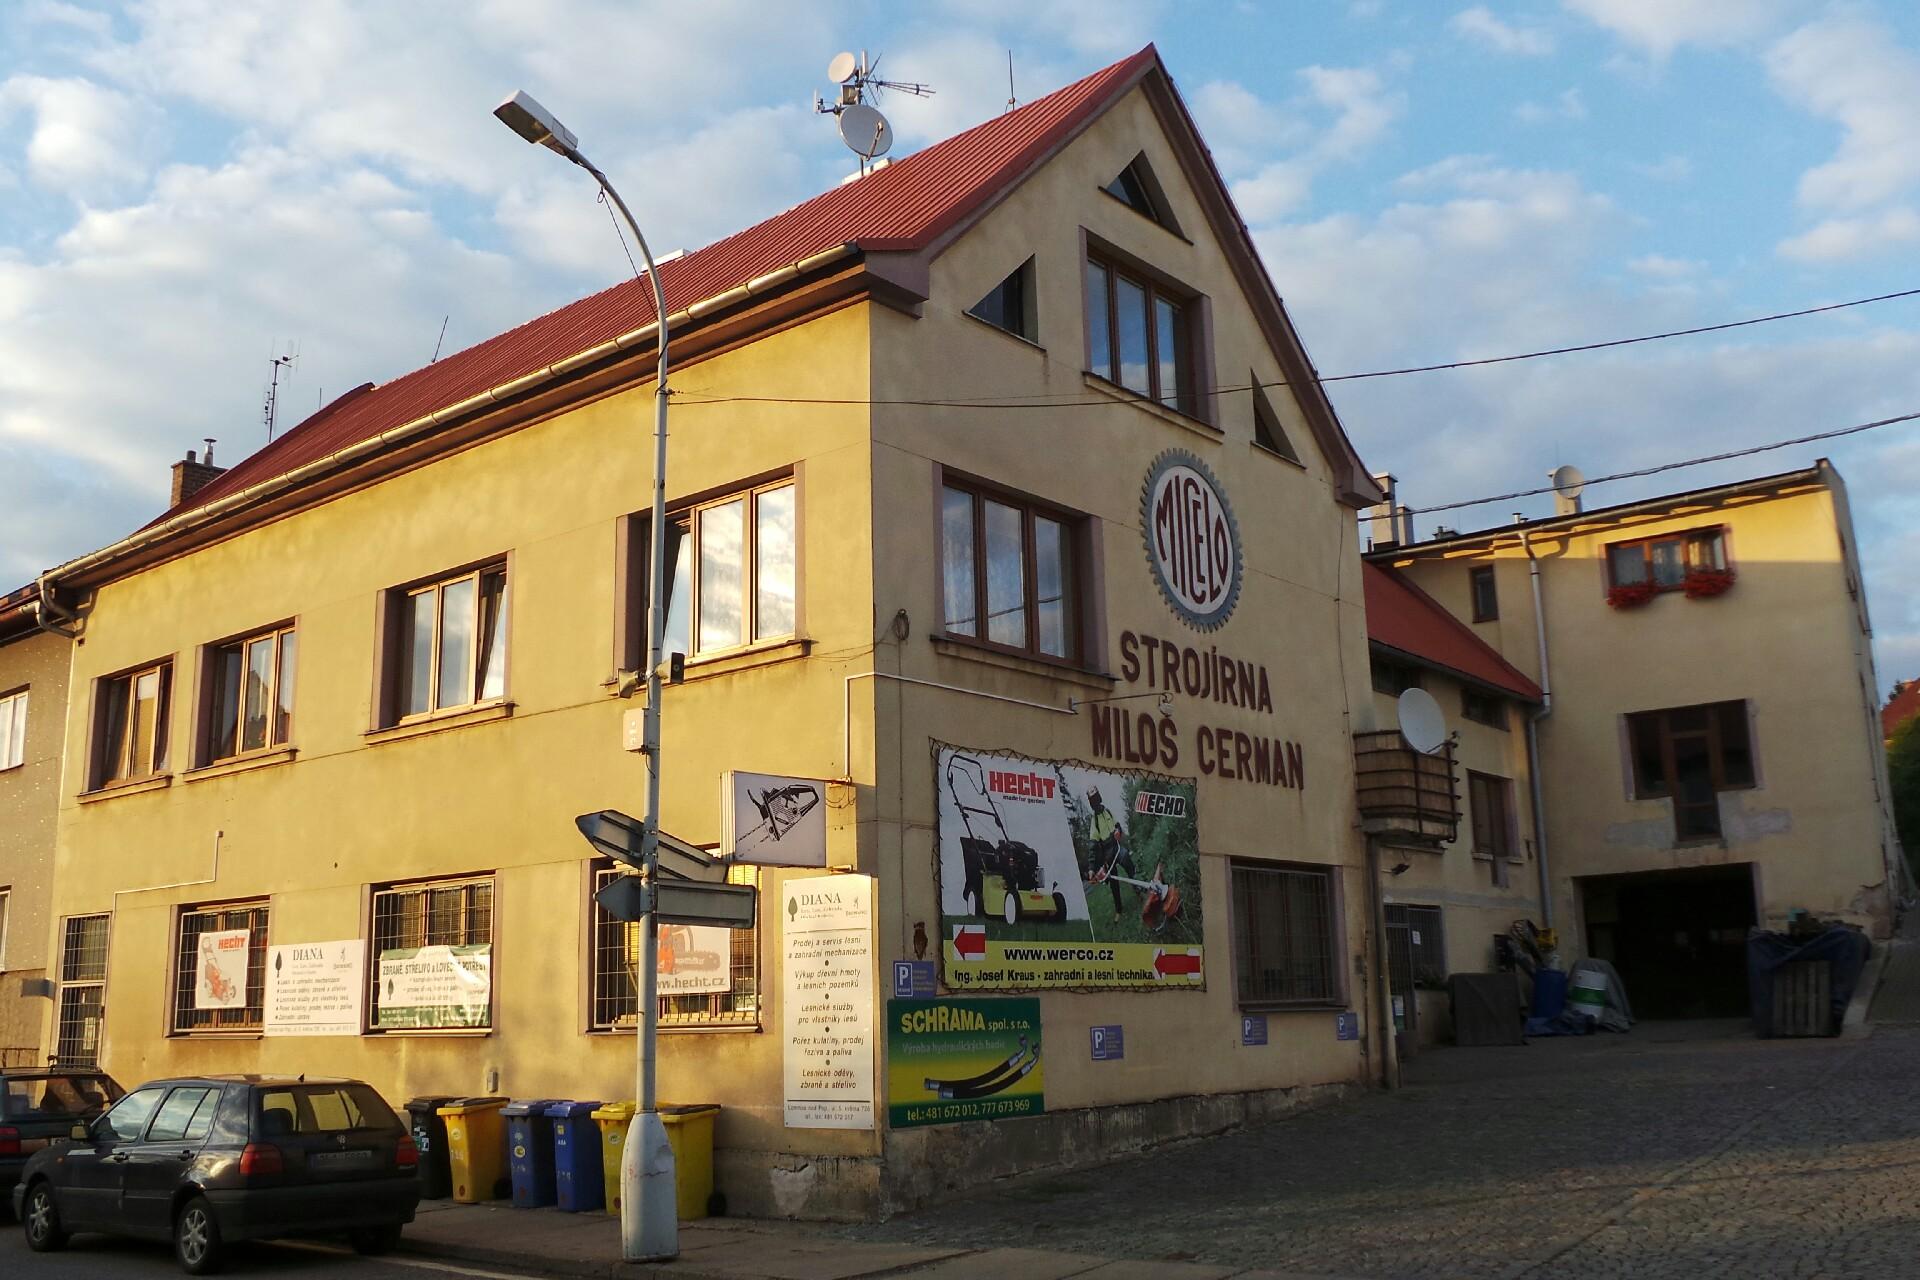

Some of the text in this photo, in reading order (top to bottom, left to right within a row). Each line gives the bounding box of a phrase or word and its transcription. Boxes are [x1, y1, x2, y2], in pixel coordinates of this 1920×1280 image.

[1119, 629, 1273, 715] STROJÍRNA
[1196, 723, 1304, 791] CERMAN
[1146, 793, 1186, 816] ECHO
[801, 892, 843, 906] DIANA
[793, 938, 814, 948] Prodej
[822, 938, 842, 946] servis
[293, 948, 324, 961] DIANA
[794, 949, 823, 959] zahradní
[824, 947, 867, 957] mechanizace
[1003, 949, 1114, 961] www.werco.cz
[795, 969, 814, 980] Výkup
[840, 968, 861, 978] hmoty
[954, 969, 973, 984] Ing.
[976, 969, 1004, 981] Josef
[1007, 969, 1035, 981] Kraus
[1043, 968, 1085, 981] zahradní
[1087, 971, 1093, 980] a
[1094, 968, 1114, 980] lesní
[828, 979, 859, 990] pozemků
[802, 1002, 854, 1012] Lesnické služby
[798, 1014, 858, 1025] pro vlastníky lesů
[987, 1017, 1009, 1032] spol.
[1010, 1021, 1016, 1029] s
[1017, 1020, 1031, 1029] r.o.
[842, 1035, 864, 1045] prodej
[832, 1048, 852, 1058] paliva
[802, 1069, 832, 1077] Lesnické
[800, 1081, 823, 1089] zbraně
[831, 1081, 857, 1089] střelivo
[926, 1106, 942, 1119] 481
[944, 1105, 961, 1118] 672
[981, 1102, 997, 1114] 777
[998, 1101, 1014, 1113] 673
[1014, 1099, 1031, 1112] 969
